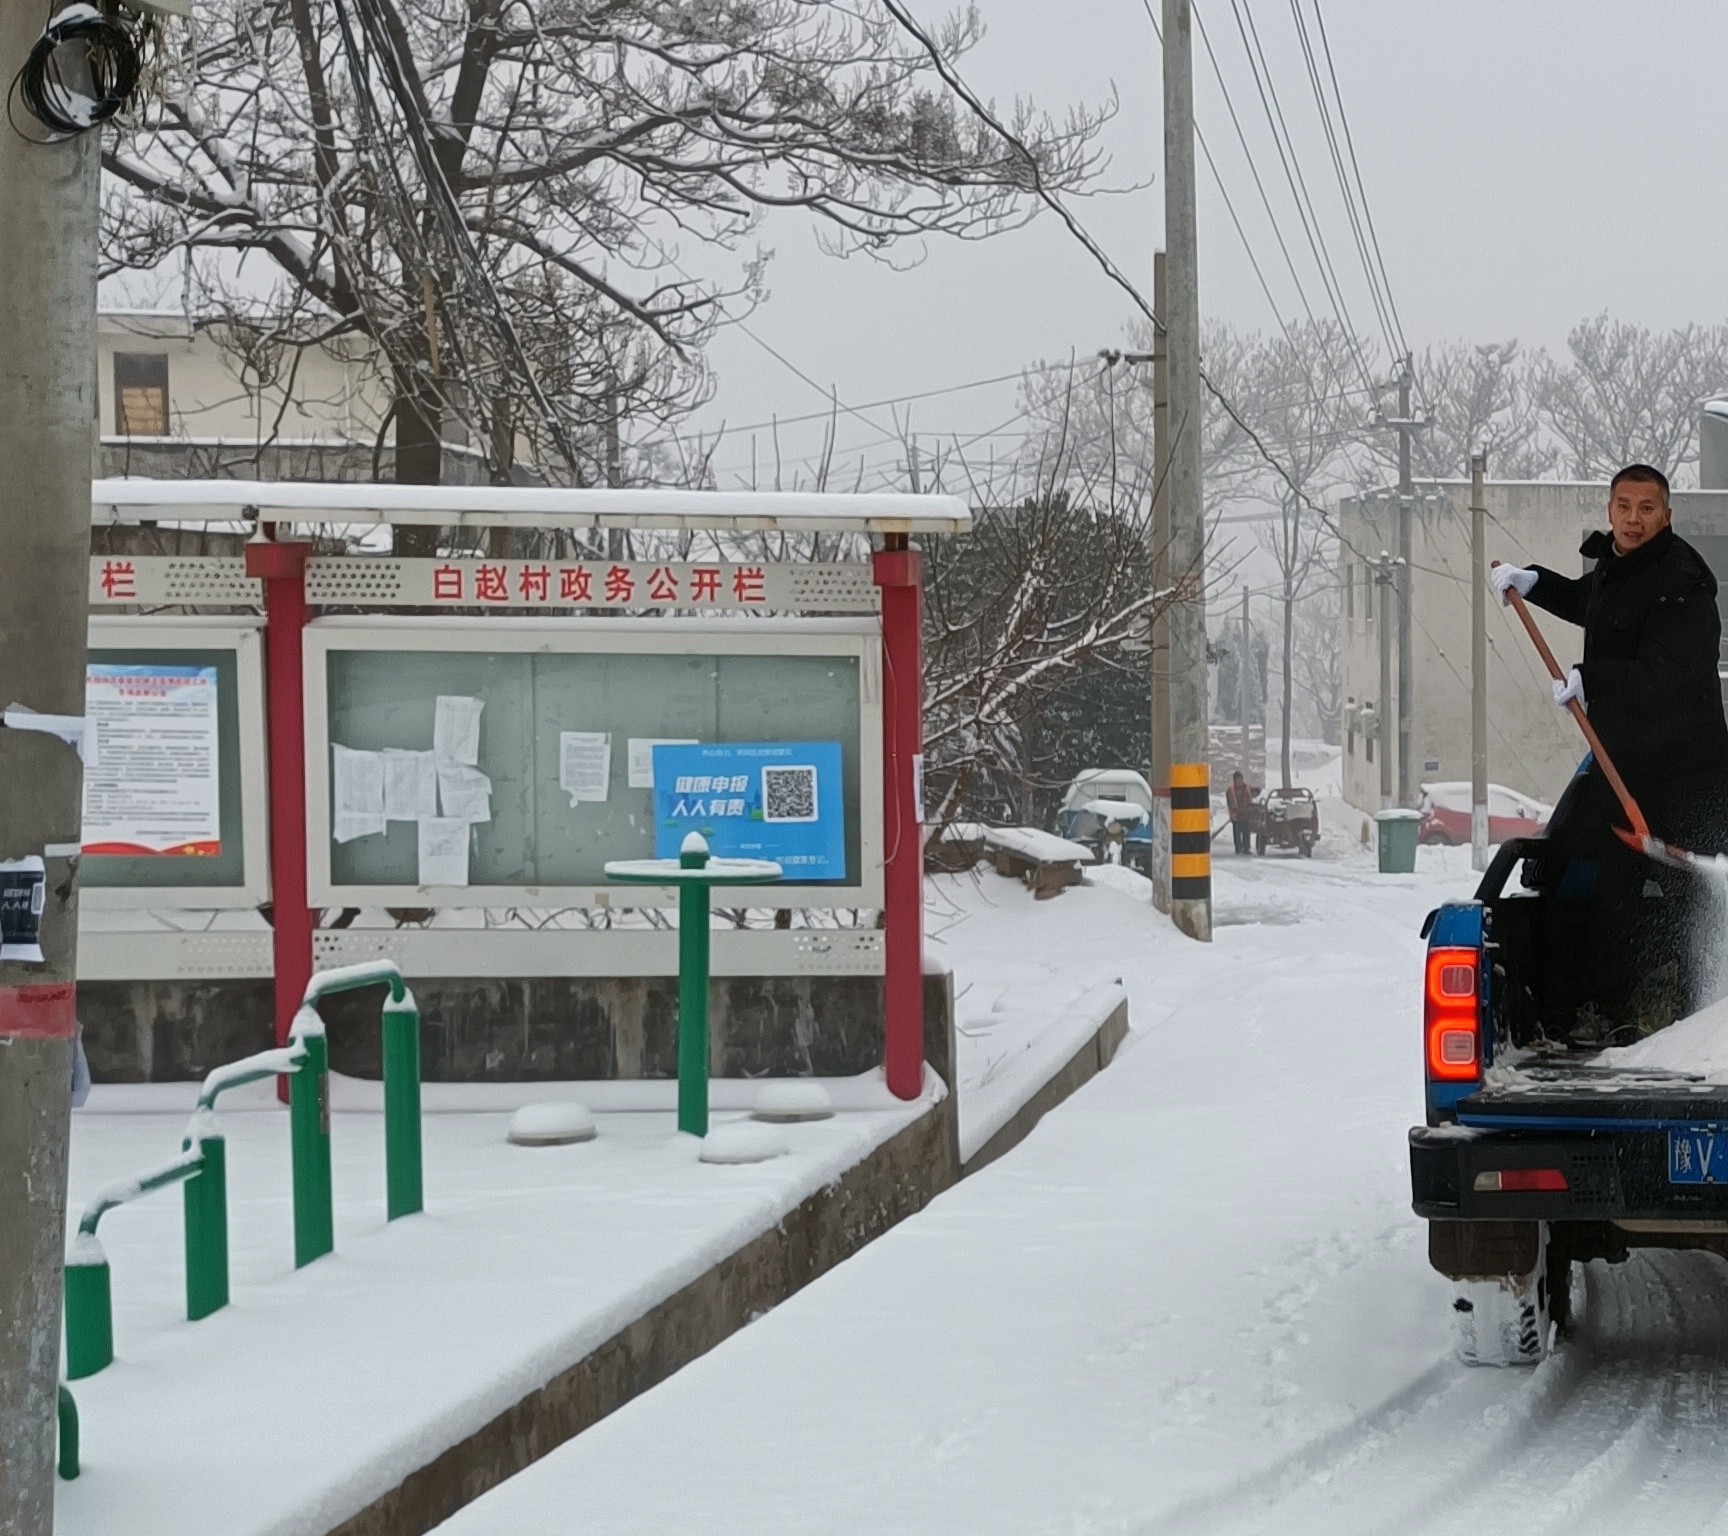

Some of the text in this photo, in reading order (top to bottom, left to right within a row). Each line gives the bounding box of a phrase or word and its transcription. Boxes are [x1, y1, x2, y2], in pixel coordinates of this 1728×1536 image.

[101, 560, 135, 598] 栏
[433, 564, 766, 602] 白赵村政务公开栏
[672, 799, 745, 817] 人人有责
